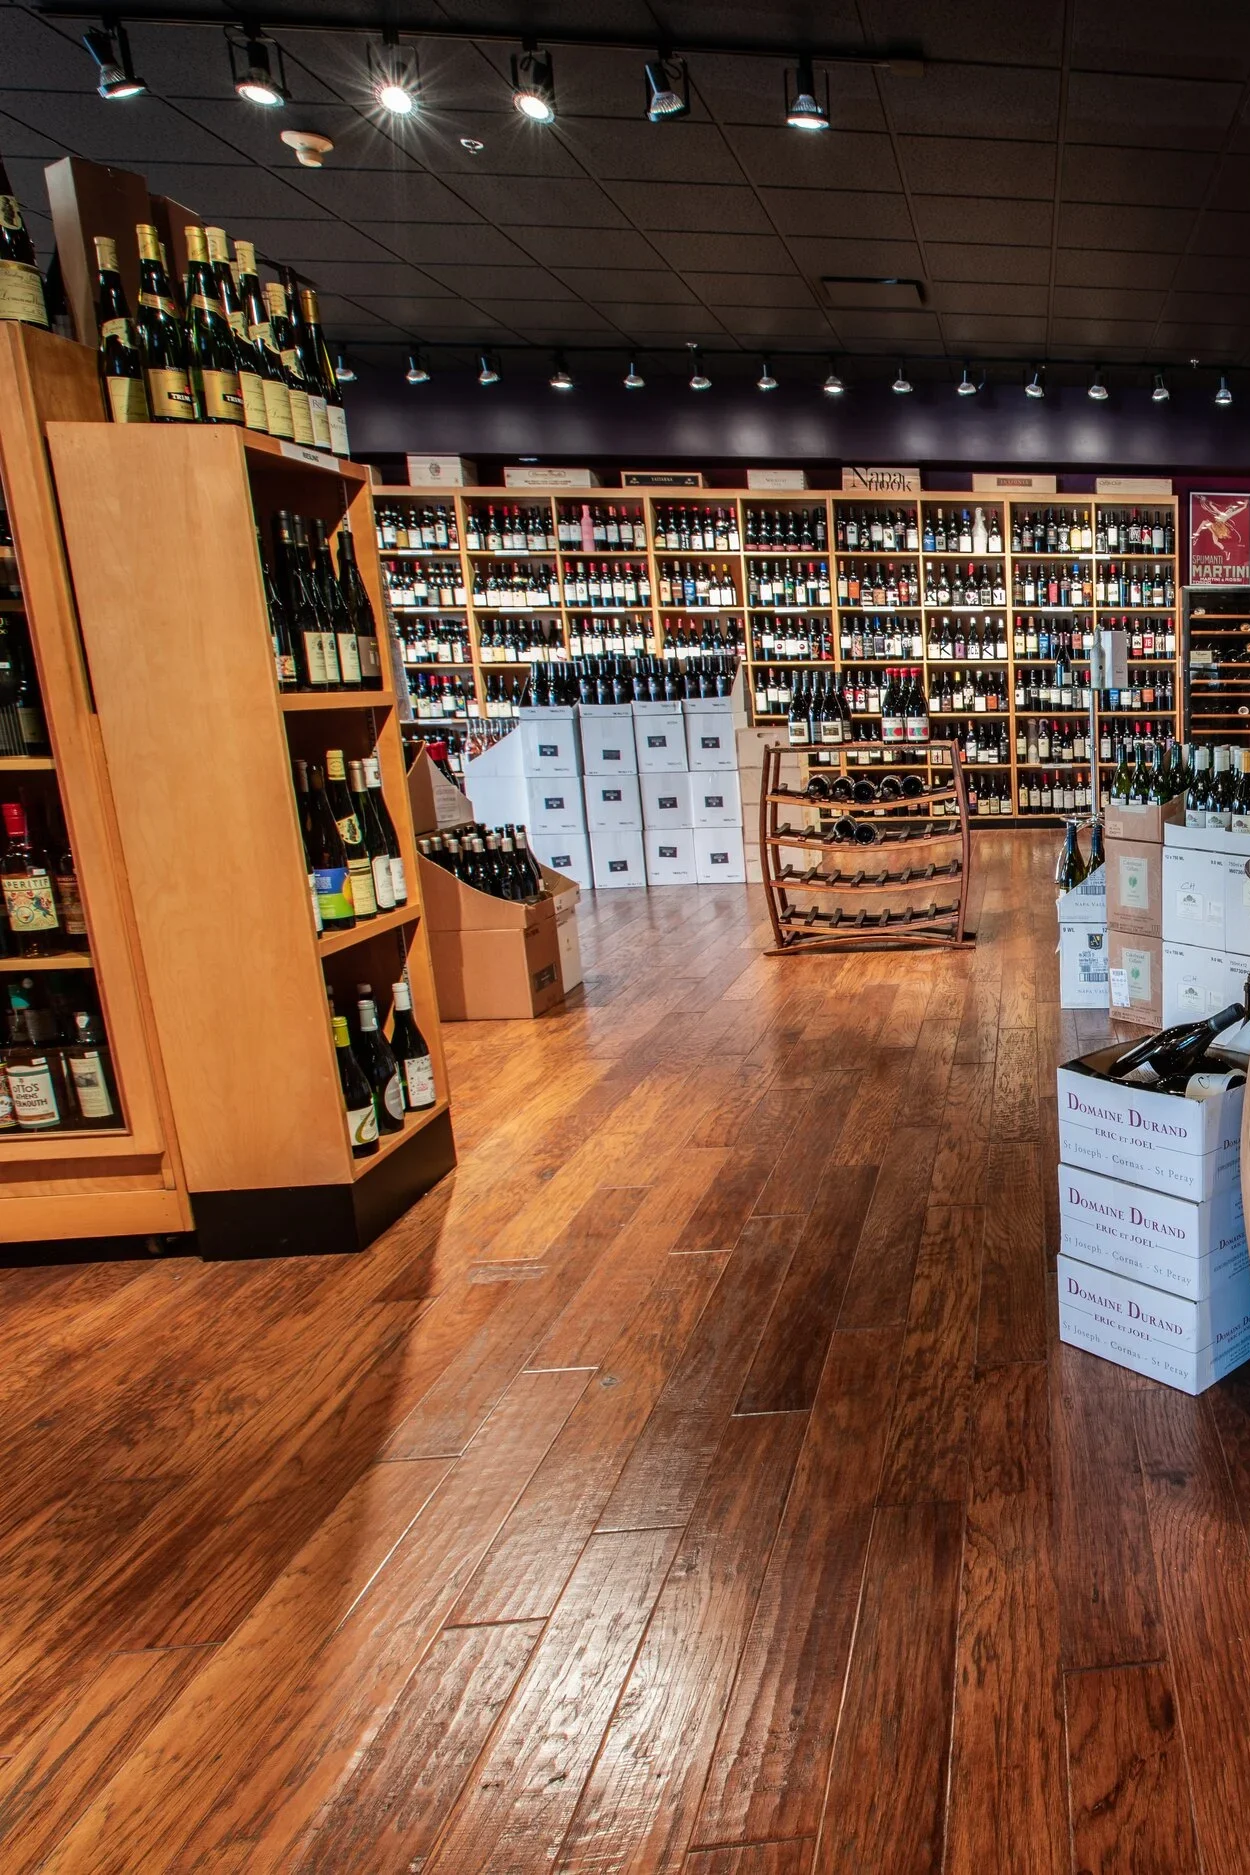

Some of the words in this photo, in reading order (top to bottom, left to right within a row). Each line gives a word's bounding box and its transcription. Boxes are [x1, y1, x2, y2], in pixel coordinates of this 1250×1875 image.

[1192, 554, 1223, 564] SPUMANTI
[1192, 564, 1250, 578] MARTINI
[3, 878, 49, 890] APERITIF
[1066, 1092, 1124, 1125] DOMAINE
[1127, 1108, 1188, 1139] DURAND
[1095, 1127, 1118, 1142] ERIC
[1129, 1136, 1156, 1151] JOEL
[1063, 1138, 1072, 1150] St
[1073, 1142, 1102, 1160] Joseph
[1112, 1153, 1144, 1171] Cornas
[1155, 1165, 1165, 1177] St
[1168, 1168, 1195, 1186] Peray
[1068, 1187, 1125, 1221] DOMAINE
[1130, 1207, 1186, 1240] DURAND
[1095, 1222, 1118, 1238] ERIC
[1129, 1233, 1157, 1249] JOEL
[1063, 1233, 1073, 1245] St
[1073, 1237, 1102, 1256] Joseph
[1112, 1249, 1144, 1269] Cornas
[1153, 1264, 1164, 1275] St
[1166, 1267, 1193, 1286] Peray
[1067, 1277, 1123, 1314] DOMAINE
[1127, 1301, 1183, 1337] DURAND
[1094, 1313, 1116, 1330] ERIC
[1127, 1325, 1153, 1343] JOEL
[1062, 1320, 1071, 1332] St
[1073, 1325, 1101, 1344] Joseph
[1110, 1340, 1142, 1361] Cornas
[1151, 1356, 1161, 1368] St
[1163, 1361, 1189, 1380] Peray
